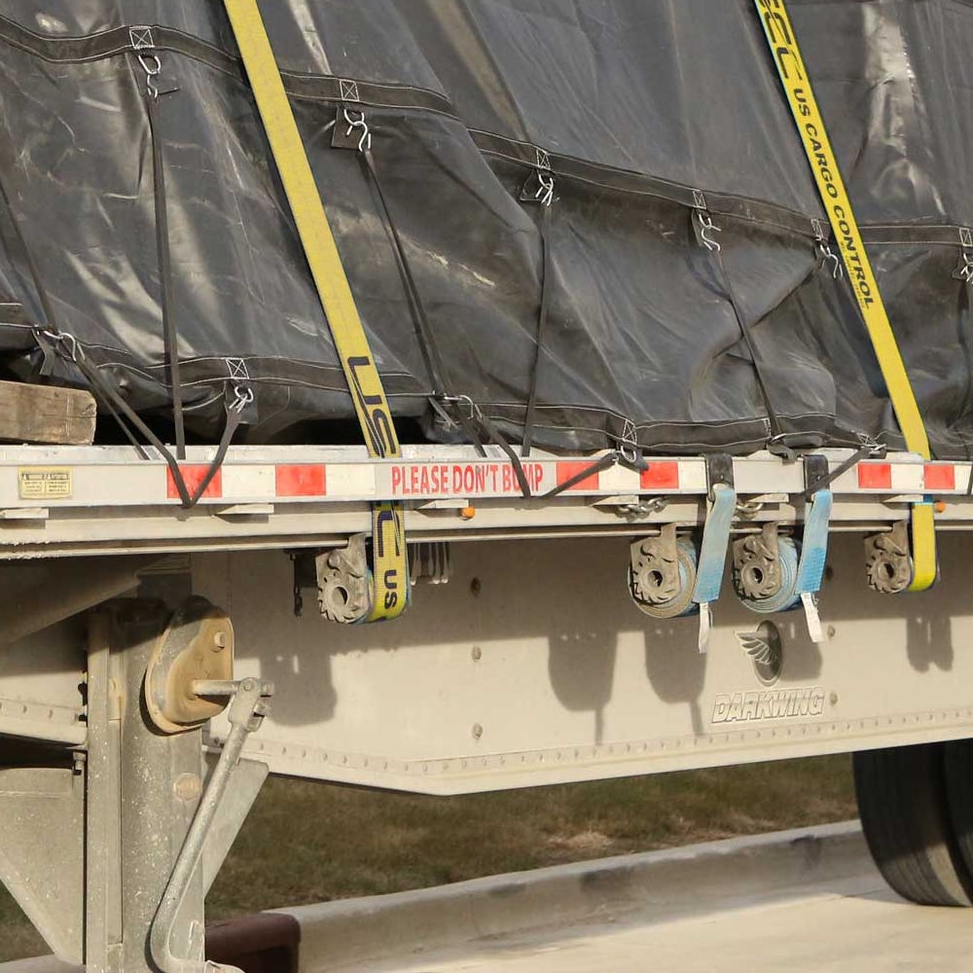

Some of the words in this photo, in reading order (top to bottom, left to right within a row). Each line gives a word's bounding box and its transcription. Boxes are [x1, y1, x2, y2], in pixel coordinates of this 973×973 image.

[793, 88, 812, 117] US
[805, 122, 838, 200] CARGO
[833, 204, 874, 310] CONTROL
[391, 465, 448, 495] PLEASE
[452, 464, 499, 494] DON'T
[383, 569, 398, 609] US
[711, 687, 825, 724] DARKWING
